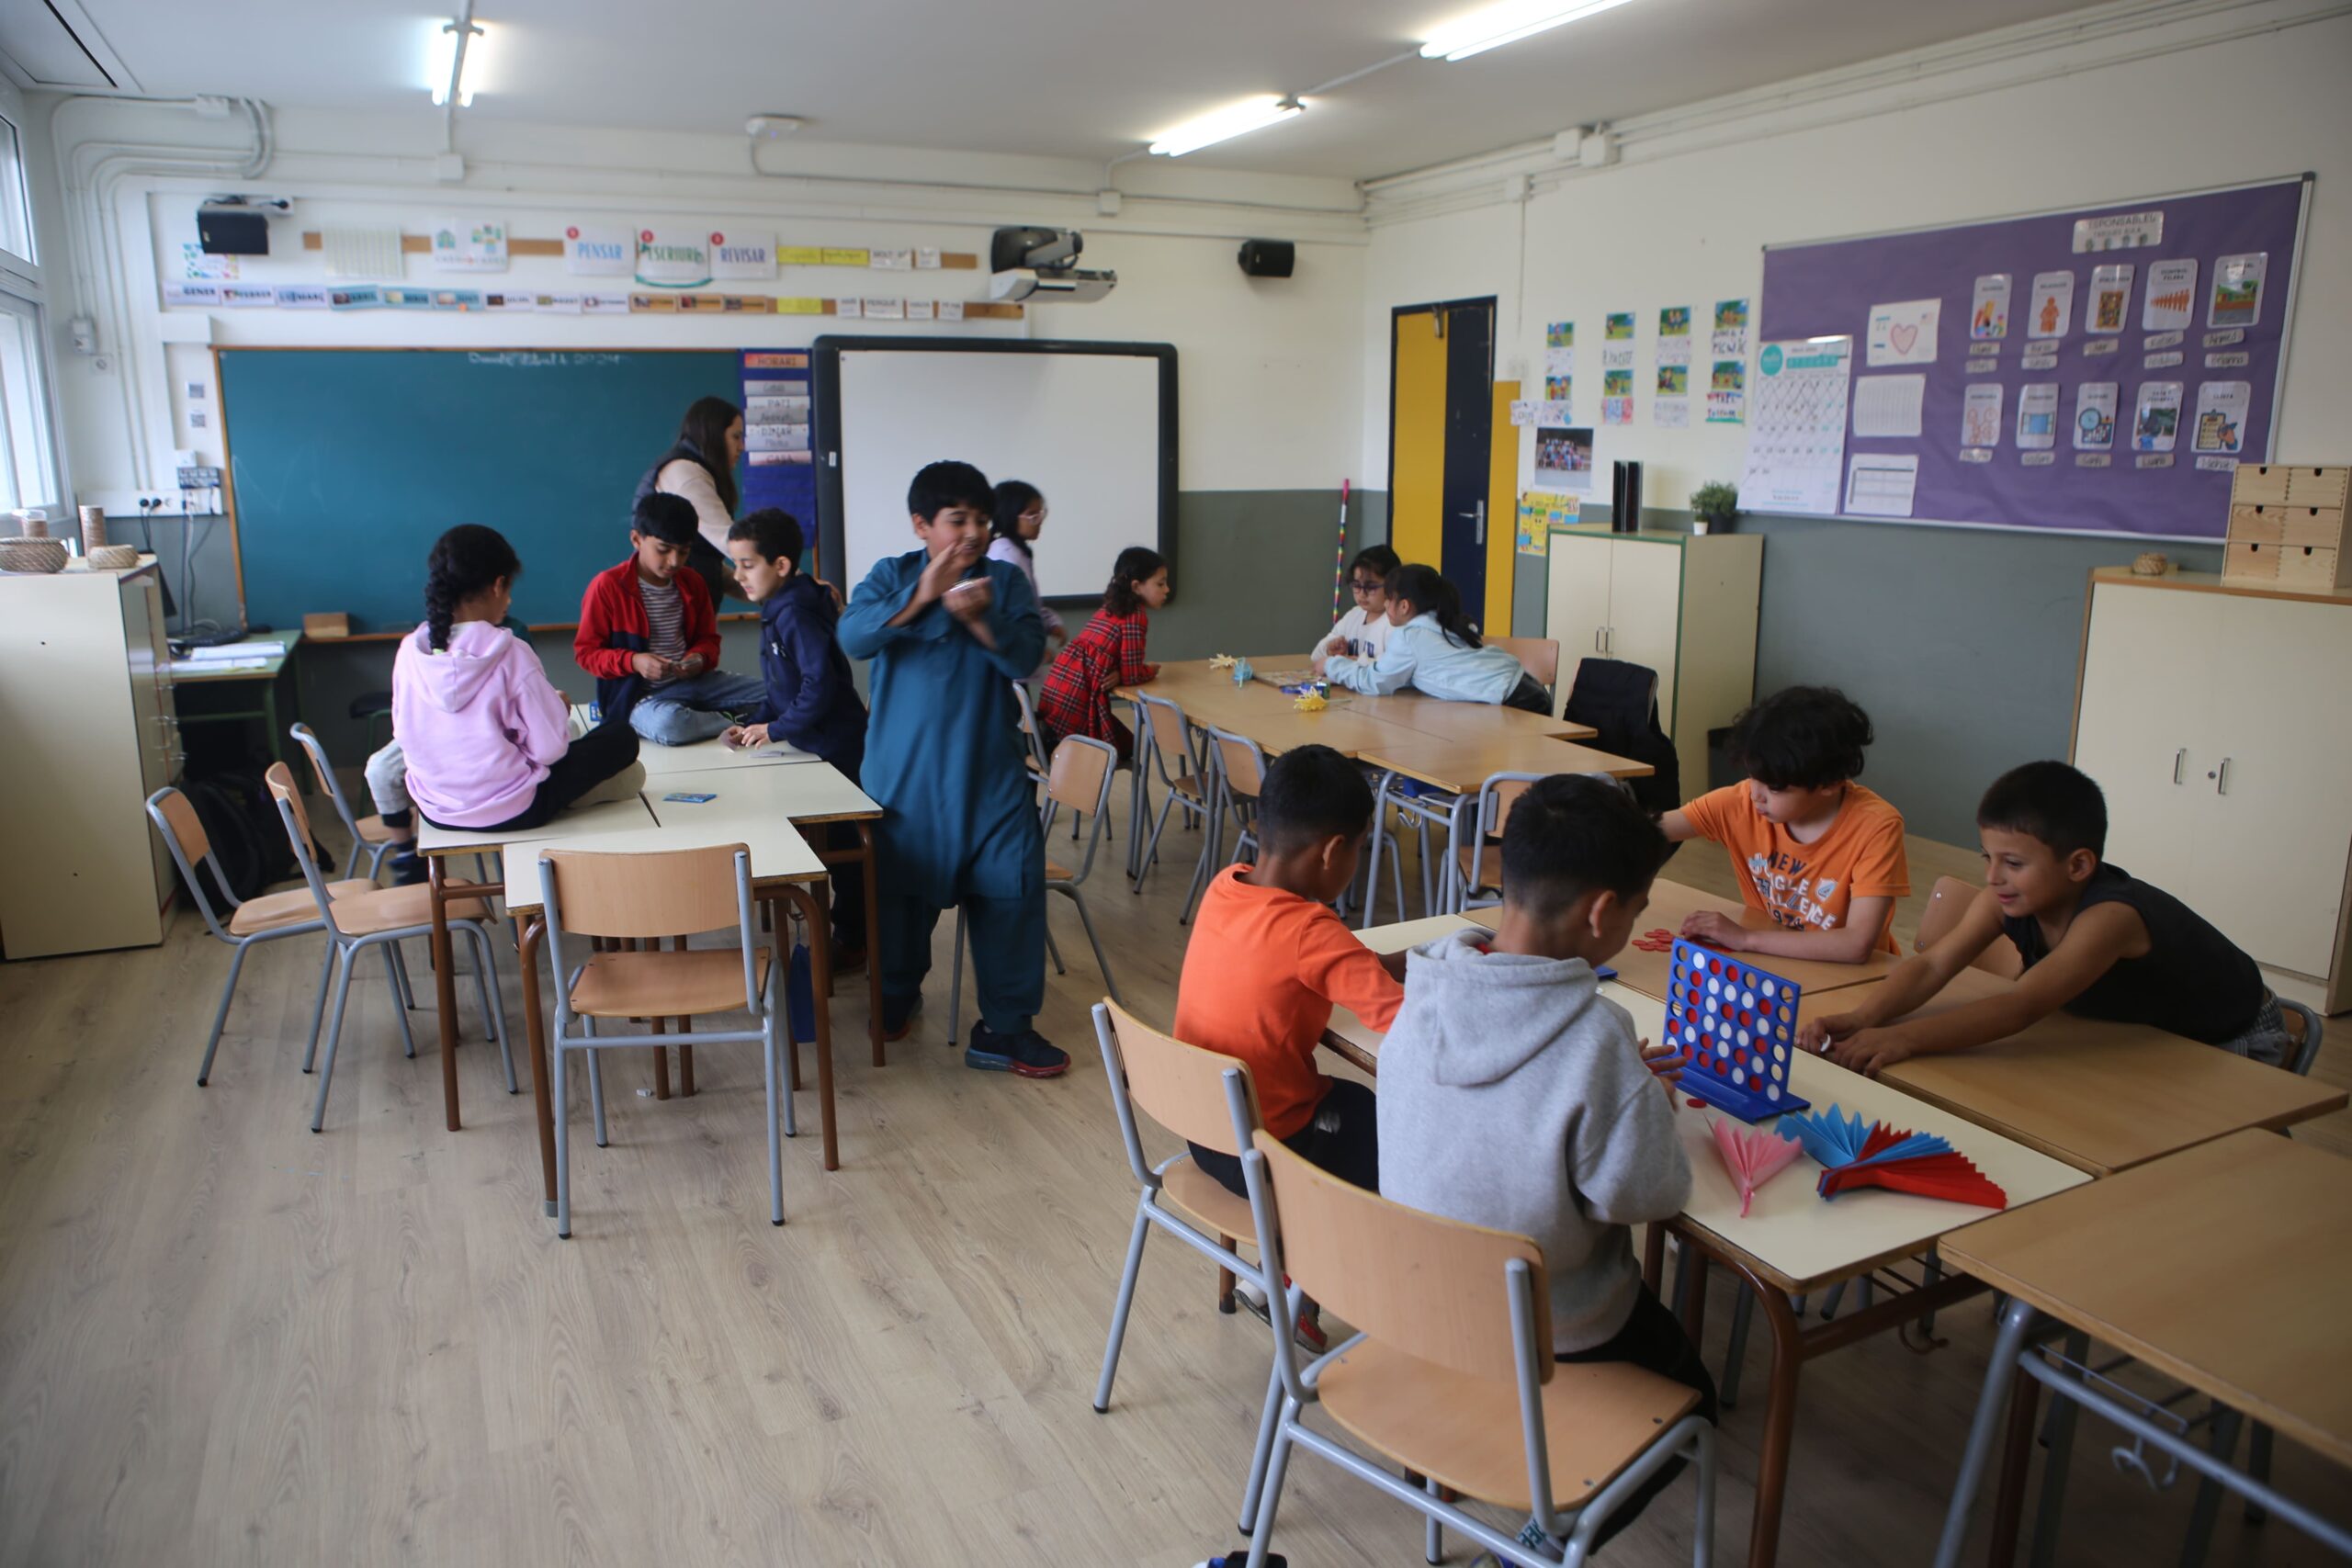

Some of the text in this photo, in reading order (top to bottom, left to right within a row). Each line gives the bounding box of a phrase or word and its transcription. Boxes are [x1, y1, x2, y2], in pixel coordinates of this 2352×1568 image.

[2086, 213, 2157, 229] ESPONSABLES
[577, 242, 623, 260] PENSAR
[720, 247, 766, 264] REVISAR
[757, 356, 797, 367] HORARI
[767, 399, 791, 408] PATI
[1767, 851, 1807, 876] NEW
